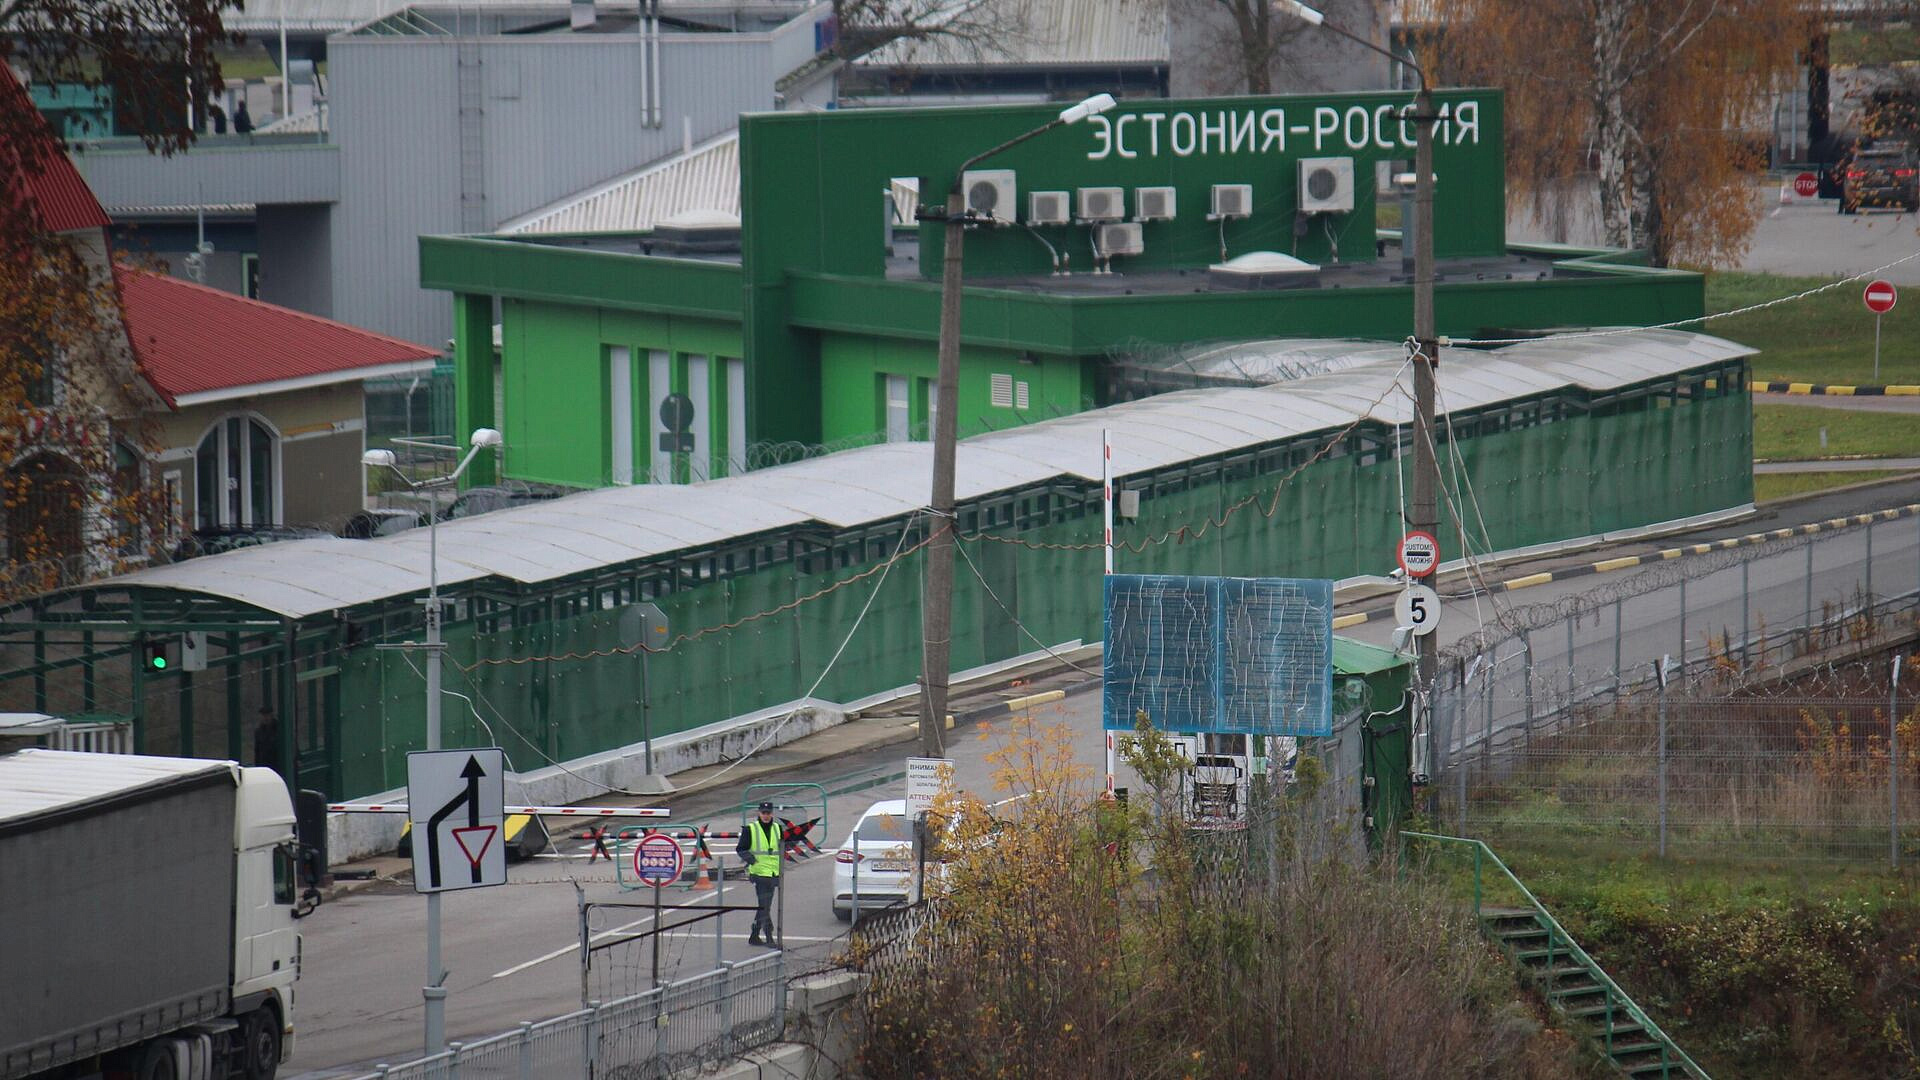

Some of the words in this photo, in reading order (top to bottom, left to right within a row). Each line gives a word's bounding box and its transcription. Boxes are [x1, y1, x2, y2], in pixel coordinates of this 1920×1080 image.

[1087, 101, 1479, 159] ЭСТОНИЯ-РОССИЯ
[1796, 179, 1818, 190] STOP
[1411, 597, 1427, 624] 5
